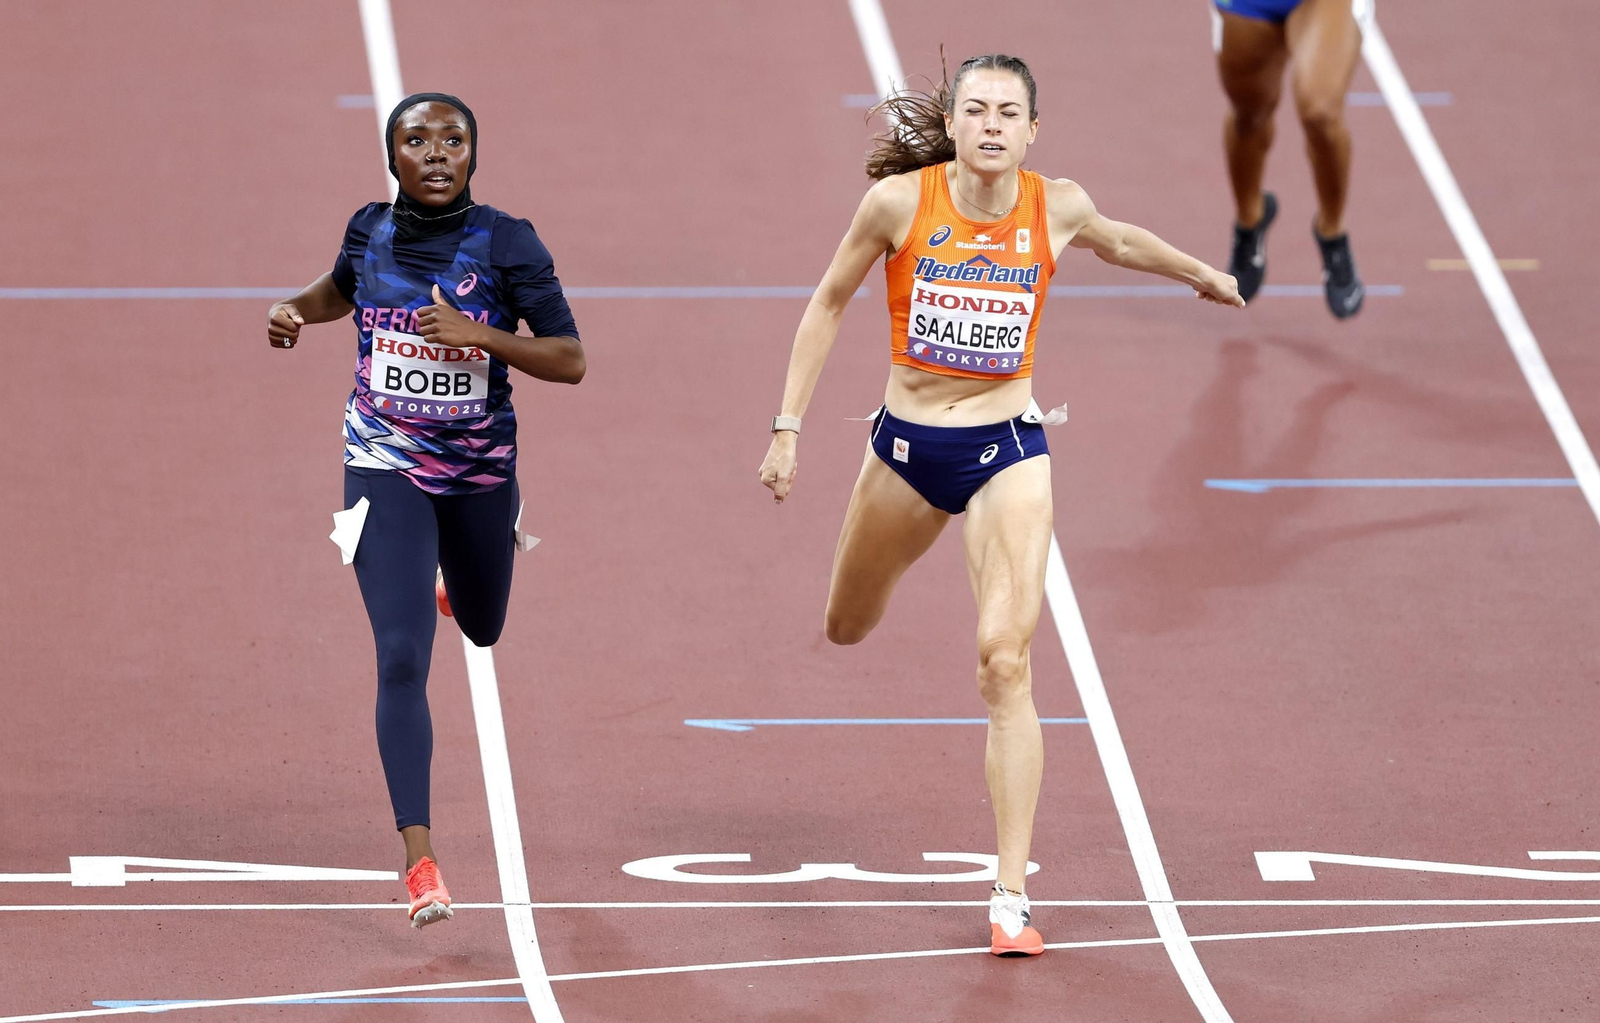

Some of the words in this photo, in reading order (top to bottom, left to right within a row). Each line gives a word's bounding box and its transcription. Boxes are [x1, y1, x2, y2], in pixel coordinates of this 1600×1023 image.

[955, 241, 1005, 251] Staatsloterij
[914, 256, 1040, 283] Nederland
[914, 287, 1030, 316] HONDA
[914, 313, 1021, 349] SAALBERG
[375, 336, 487, 362] HONDA
[385, 365, 472, 397] BOBB
